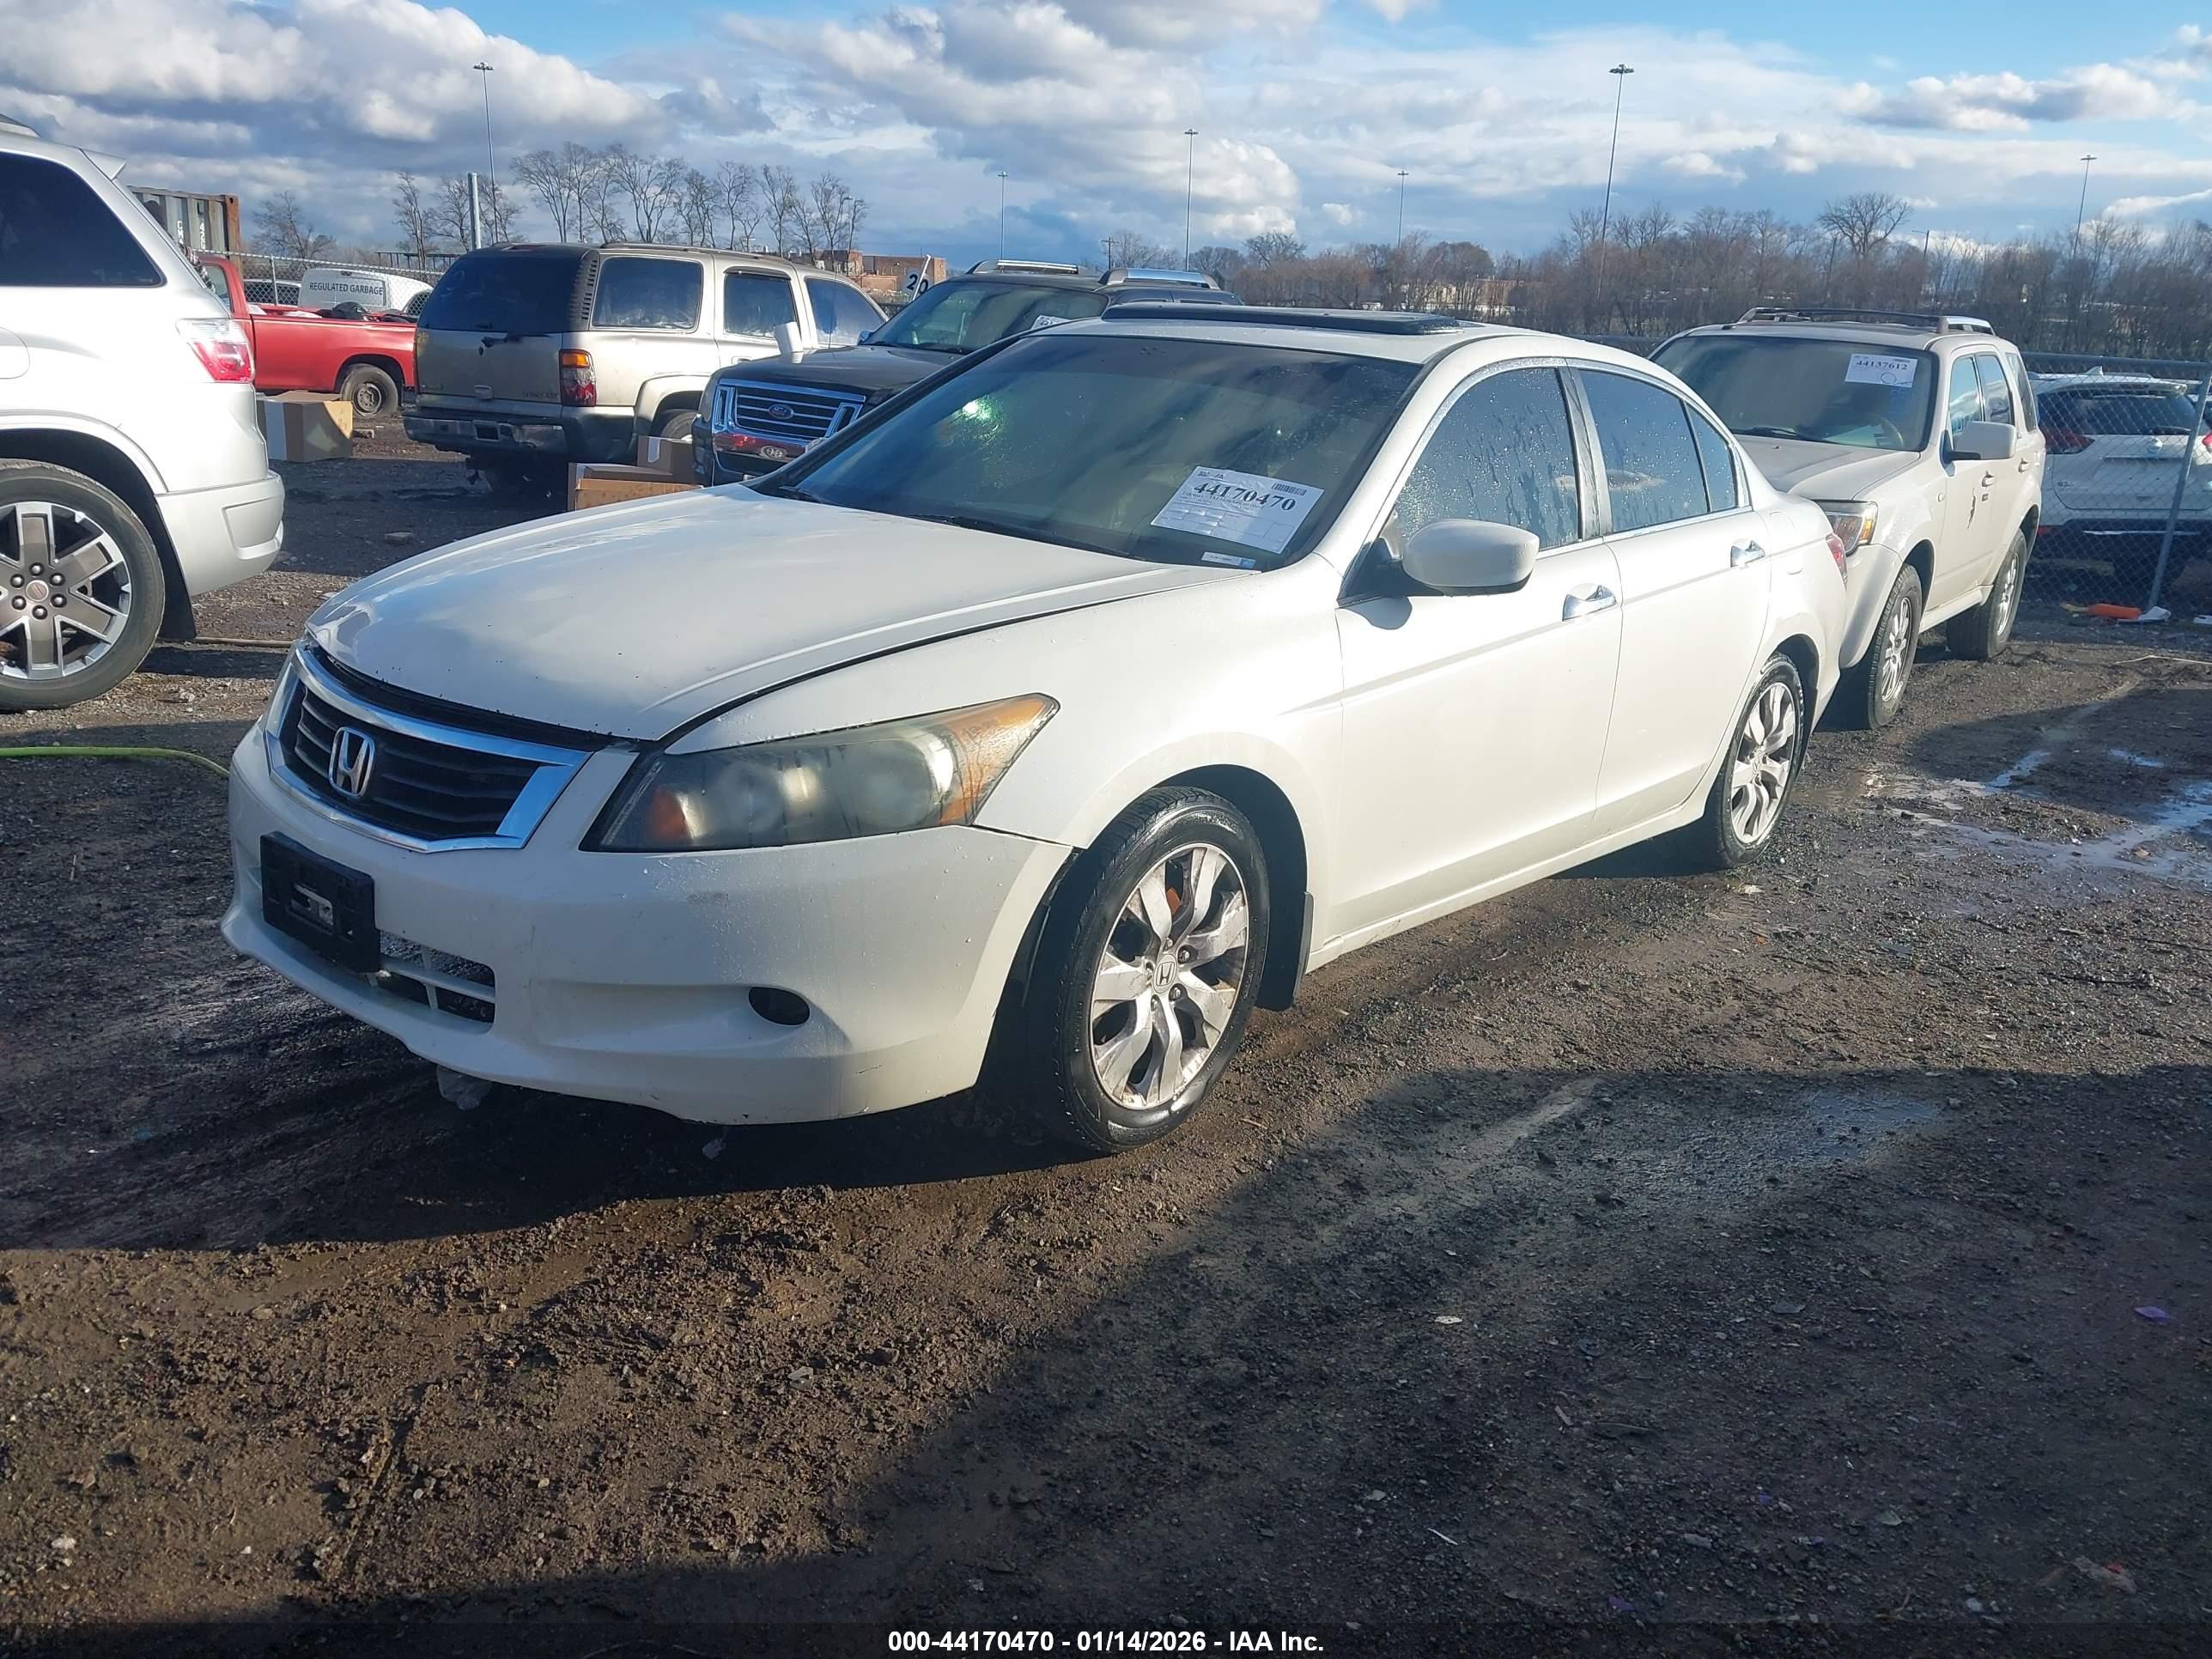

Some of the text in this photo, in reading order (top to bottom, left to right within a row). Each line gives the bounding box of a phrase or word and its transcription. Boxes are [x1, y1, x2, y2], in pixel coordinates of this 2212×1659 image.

[309, 282, 384, 295] REGULATED GARBAGE
[907, 274, 929, 295] 20
[1856, 361, 1908, 371] 44137612
[1194, 482, 1297, 511] 44170470
